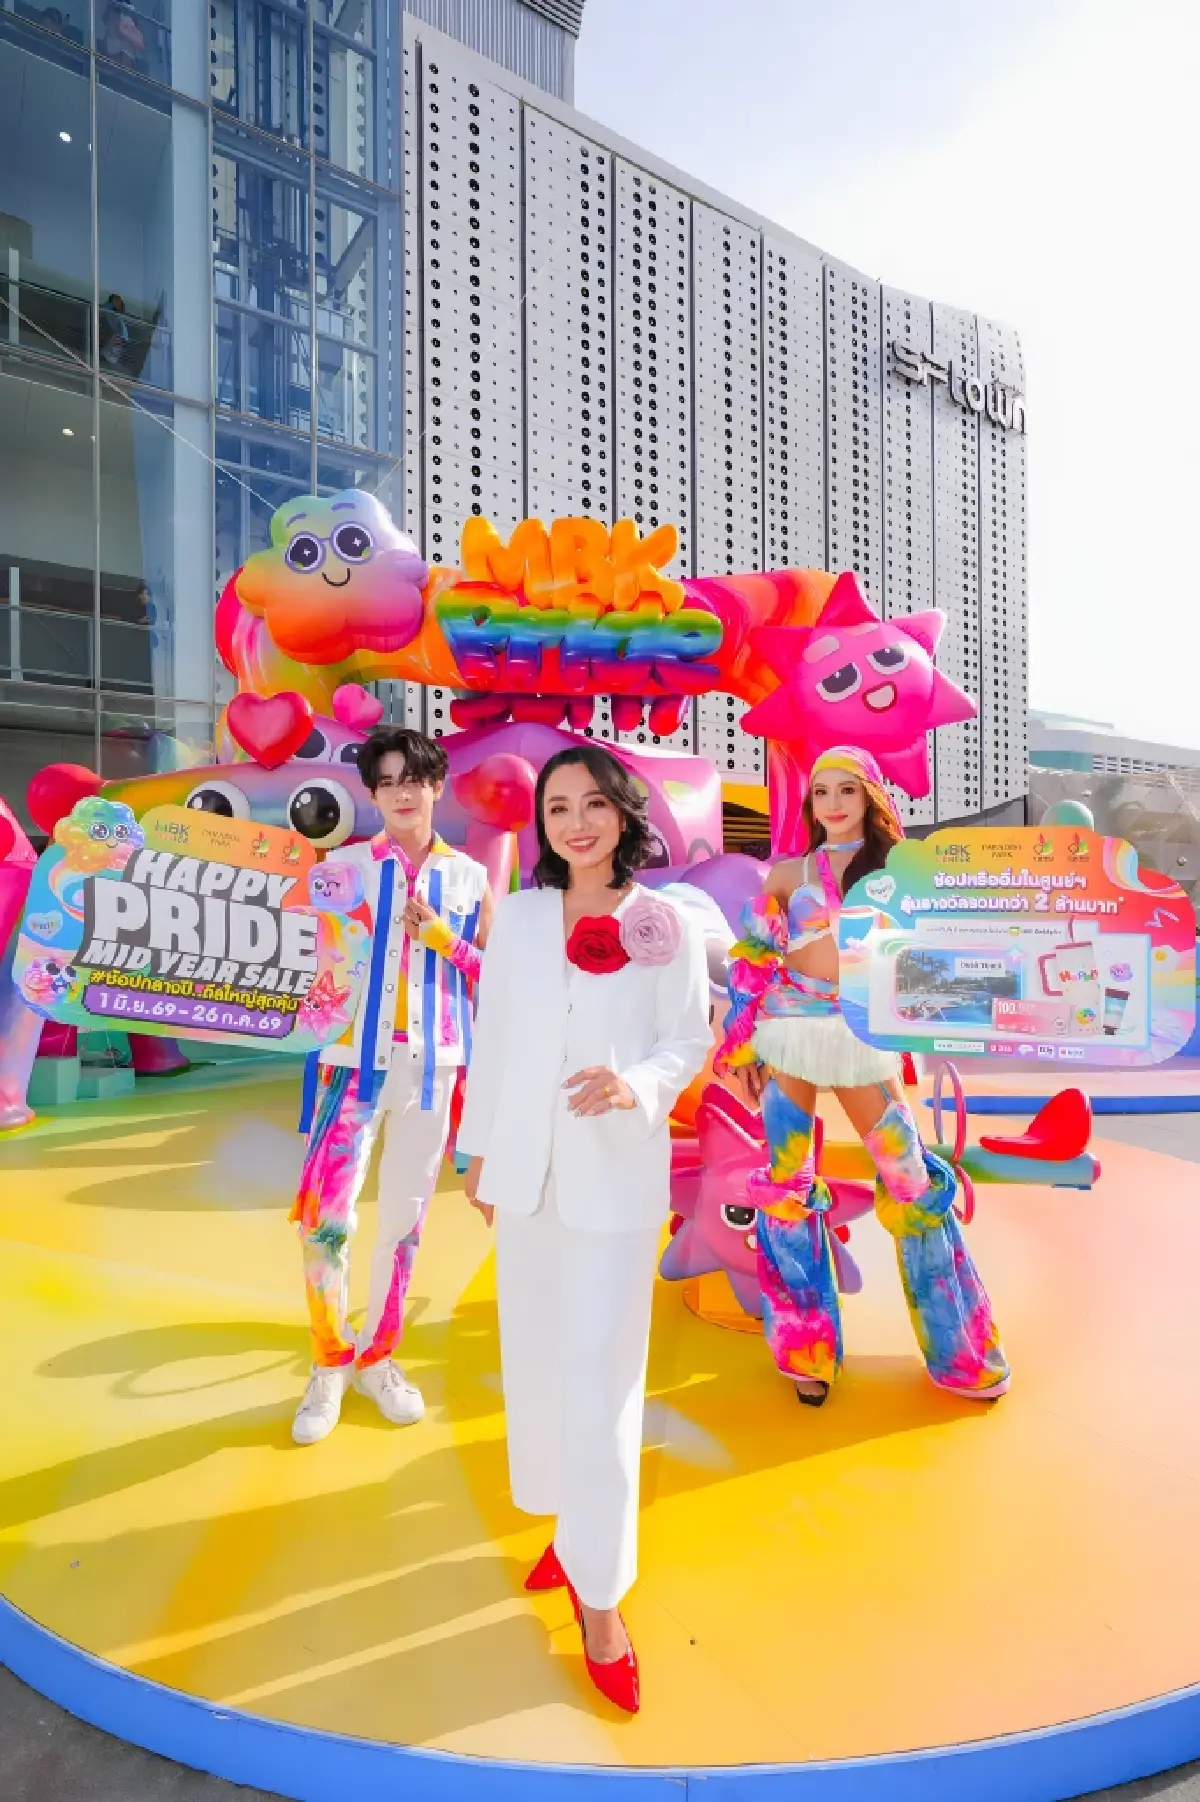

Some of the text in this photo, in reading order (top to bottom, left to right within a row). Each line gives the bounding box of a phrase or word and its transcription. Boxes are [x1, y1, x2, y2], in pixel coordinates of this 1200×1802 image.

[461, 515, 686, 613] MBK
[132, 850, 298, 908] HAPPY
[1034, 893, 1049, 911] 2
[92, 876, 319, 972] PRIDE
[84, 938, 316, 994] MID YEAR SALE
[192, 1005, 219, 1022] 26
[258, 1016, 282, 1030] 69
